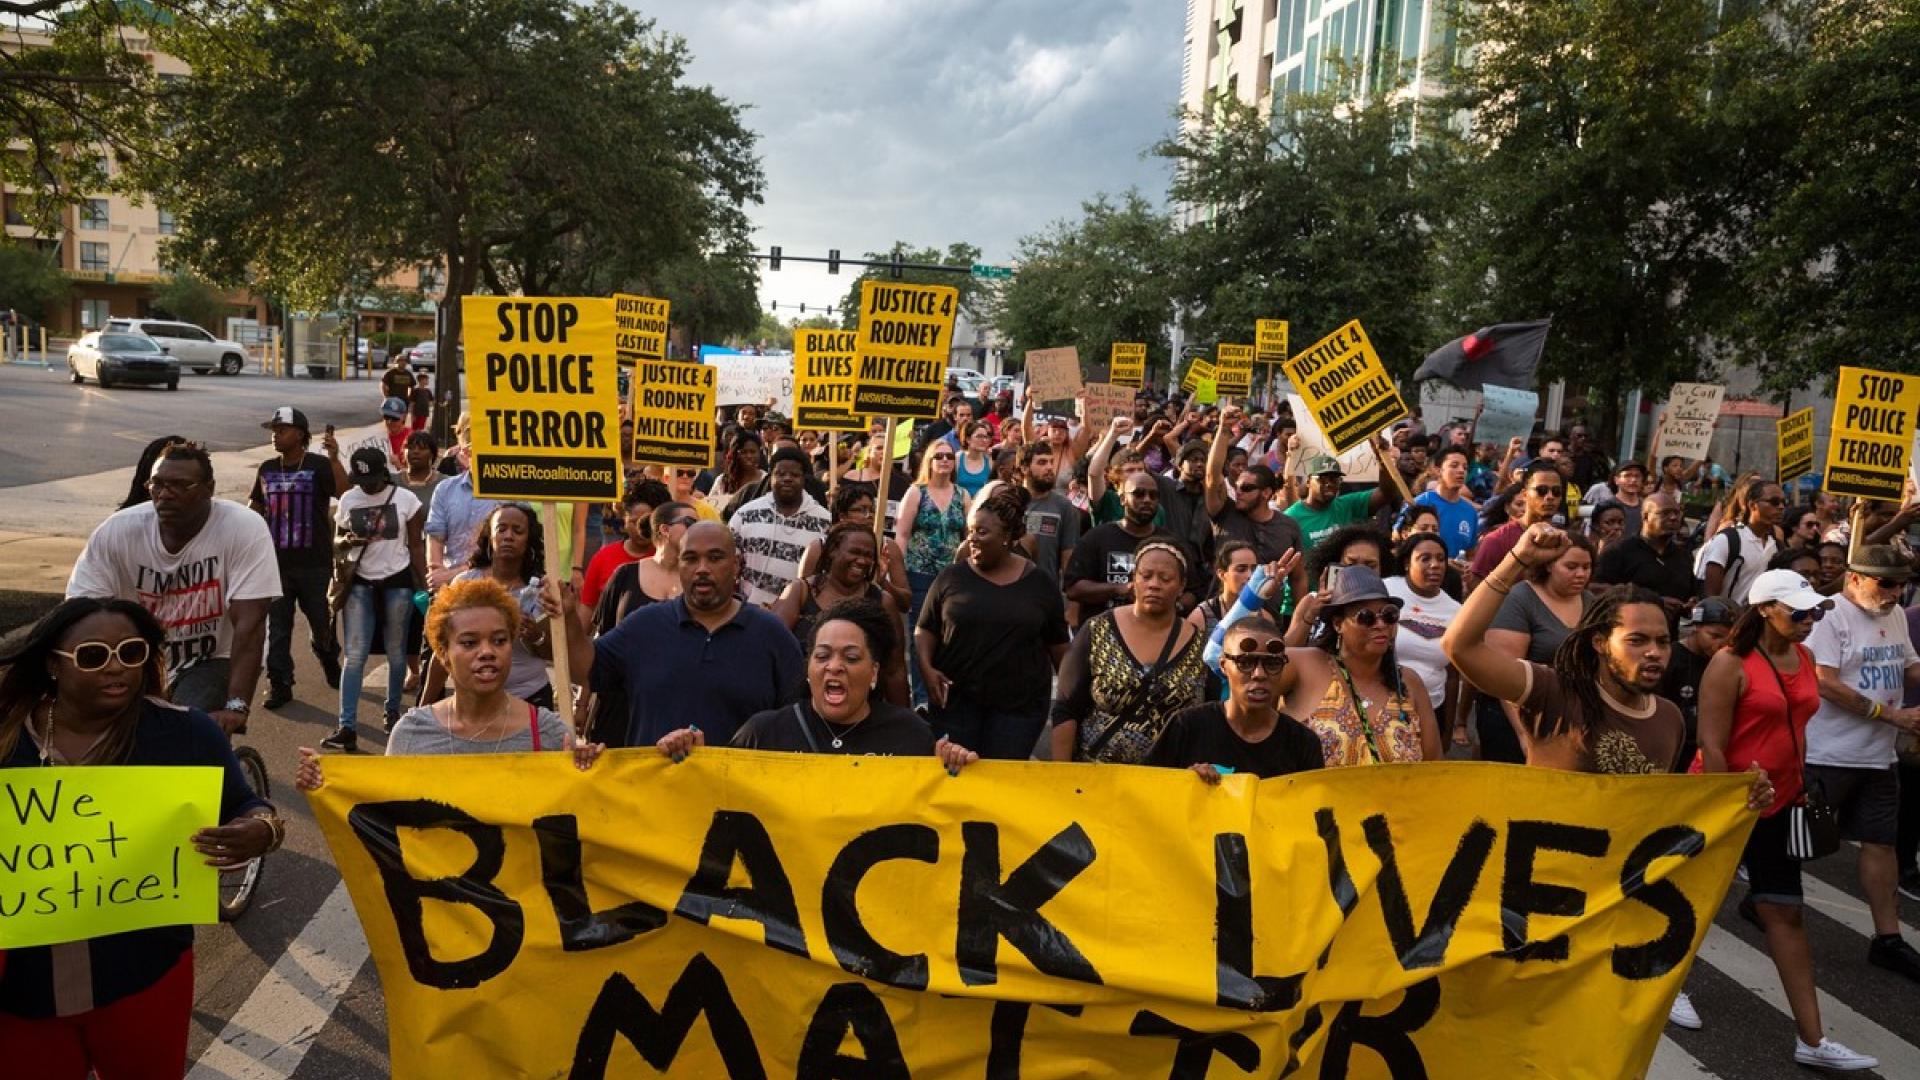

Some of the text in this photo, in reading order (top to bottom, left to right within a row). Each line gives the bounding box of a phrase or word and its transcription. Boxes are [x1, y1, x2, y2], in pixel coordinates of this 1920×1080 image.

[616, 298, 664, 316] JUSTICE 4
[870, 287, 952, 316] JUSTICE 4
[497, 302, 578, 343] STOP
[870, 320, 941, 347] RODNEY
[616, 333, 659, 352] CASTILE
[806, 334, 857, 352] BLACK
[1293, 326, 1362, 384] JUSTICE 4
[486, 353, 594, 394] POLICE
[641, 363, 698, 386] JUSTICE
[703, 369, 713, 388] 4
[808, 357, 852, 377] LIVES
[859, 356, 941, 384] MITCHELL
[1309, 351, 1369, 401] RODNEY
[643, 390, 706, 412] RODNEY
[801, 384, 852, 403] MATTE
[858, 392, 936, 409] ANSWERcoalition.org
[1318, 374, 1391, 428] MITCHELL
[1858, 374, 1905, 403] STOP
[485, 408, 607, 449] TERROR
[637, 416, 710, 441] MITCHELL
[1846, 404, 1907, 436] POLICE
[1839, 439, 1904, 468] TERROR
[482, 462, 613, 484] ANSWERcoalition.org
[175, 556, 219, 590] NOT
[5, 779, 102, 826] We
[0, 846, 180, 917] ustice!
[348, 798, 1706, 1012] BLACK LIVES
